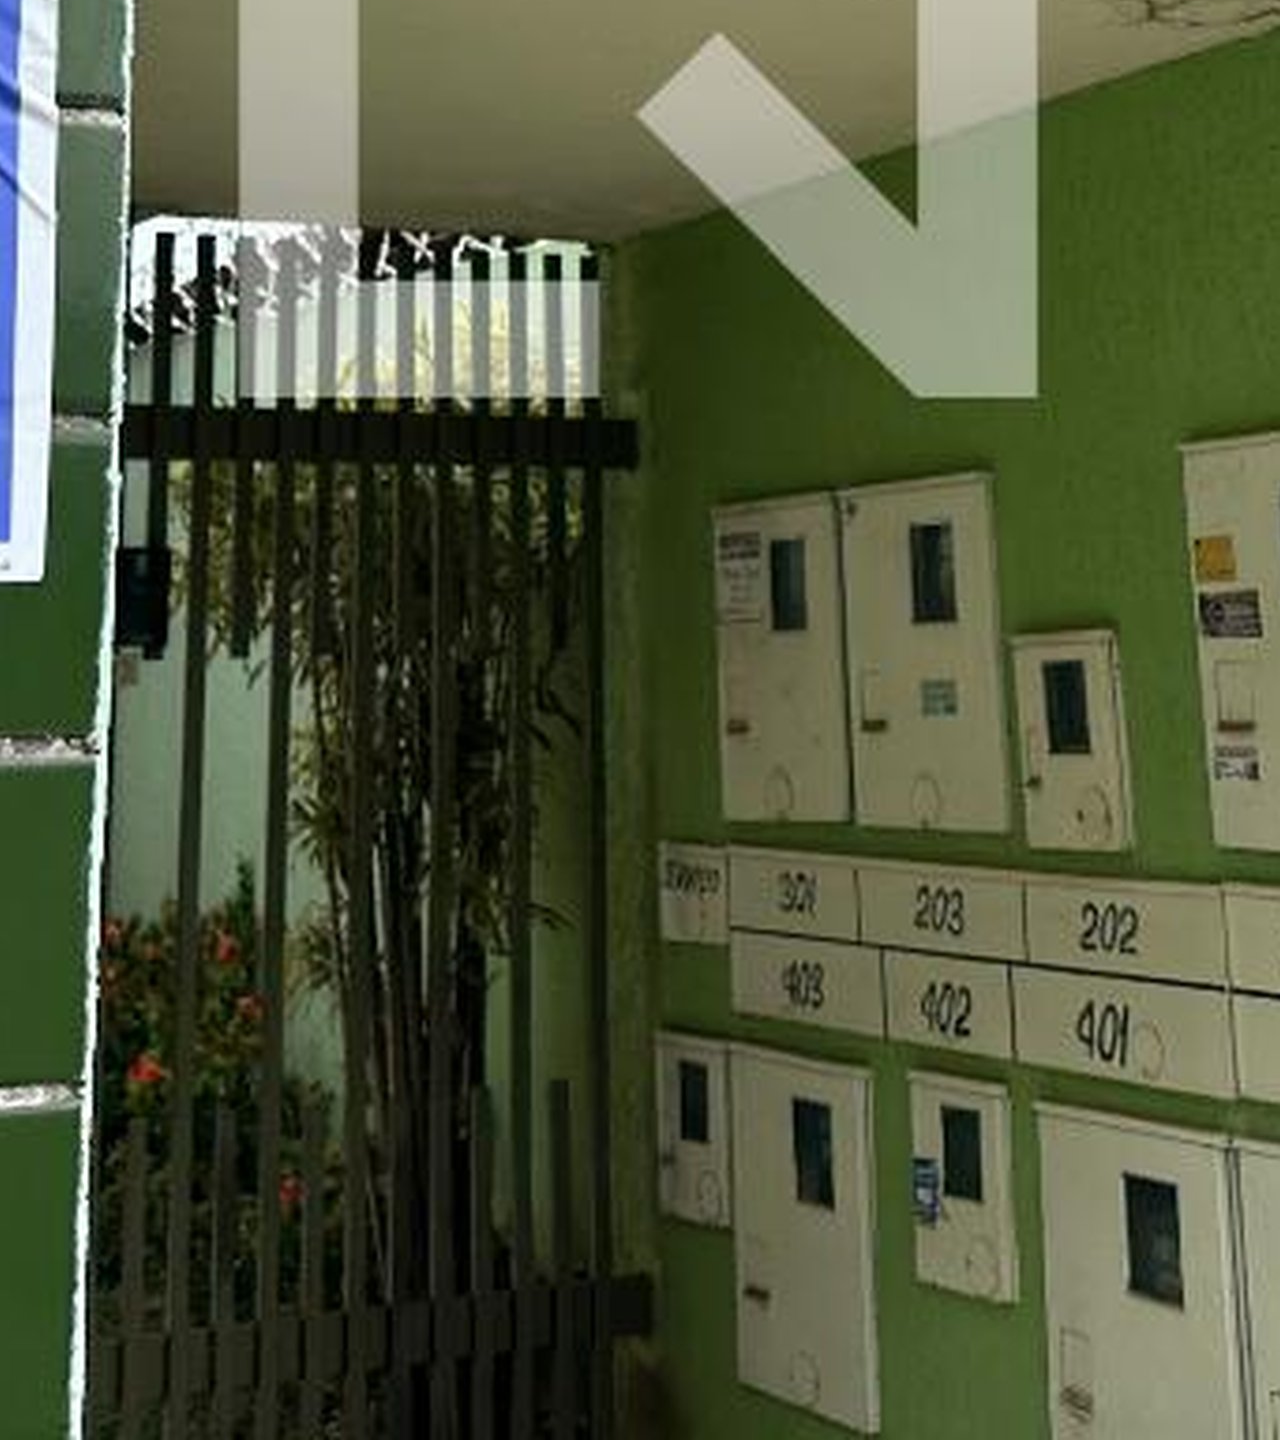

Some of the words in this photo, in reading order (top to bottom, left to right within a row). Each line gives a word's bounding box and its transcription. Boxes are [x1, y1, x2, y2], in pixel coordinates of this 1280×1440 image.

[914, 885, 965, 937] 203
[1080, 902, 1139, 955] 202
[782, 960, 825, 1010] 403
[921, 982, 972, 1038] 402
[1075, 998, 1130, 1068] 401
